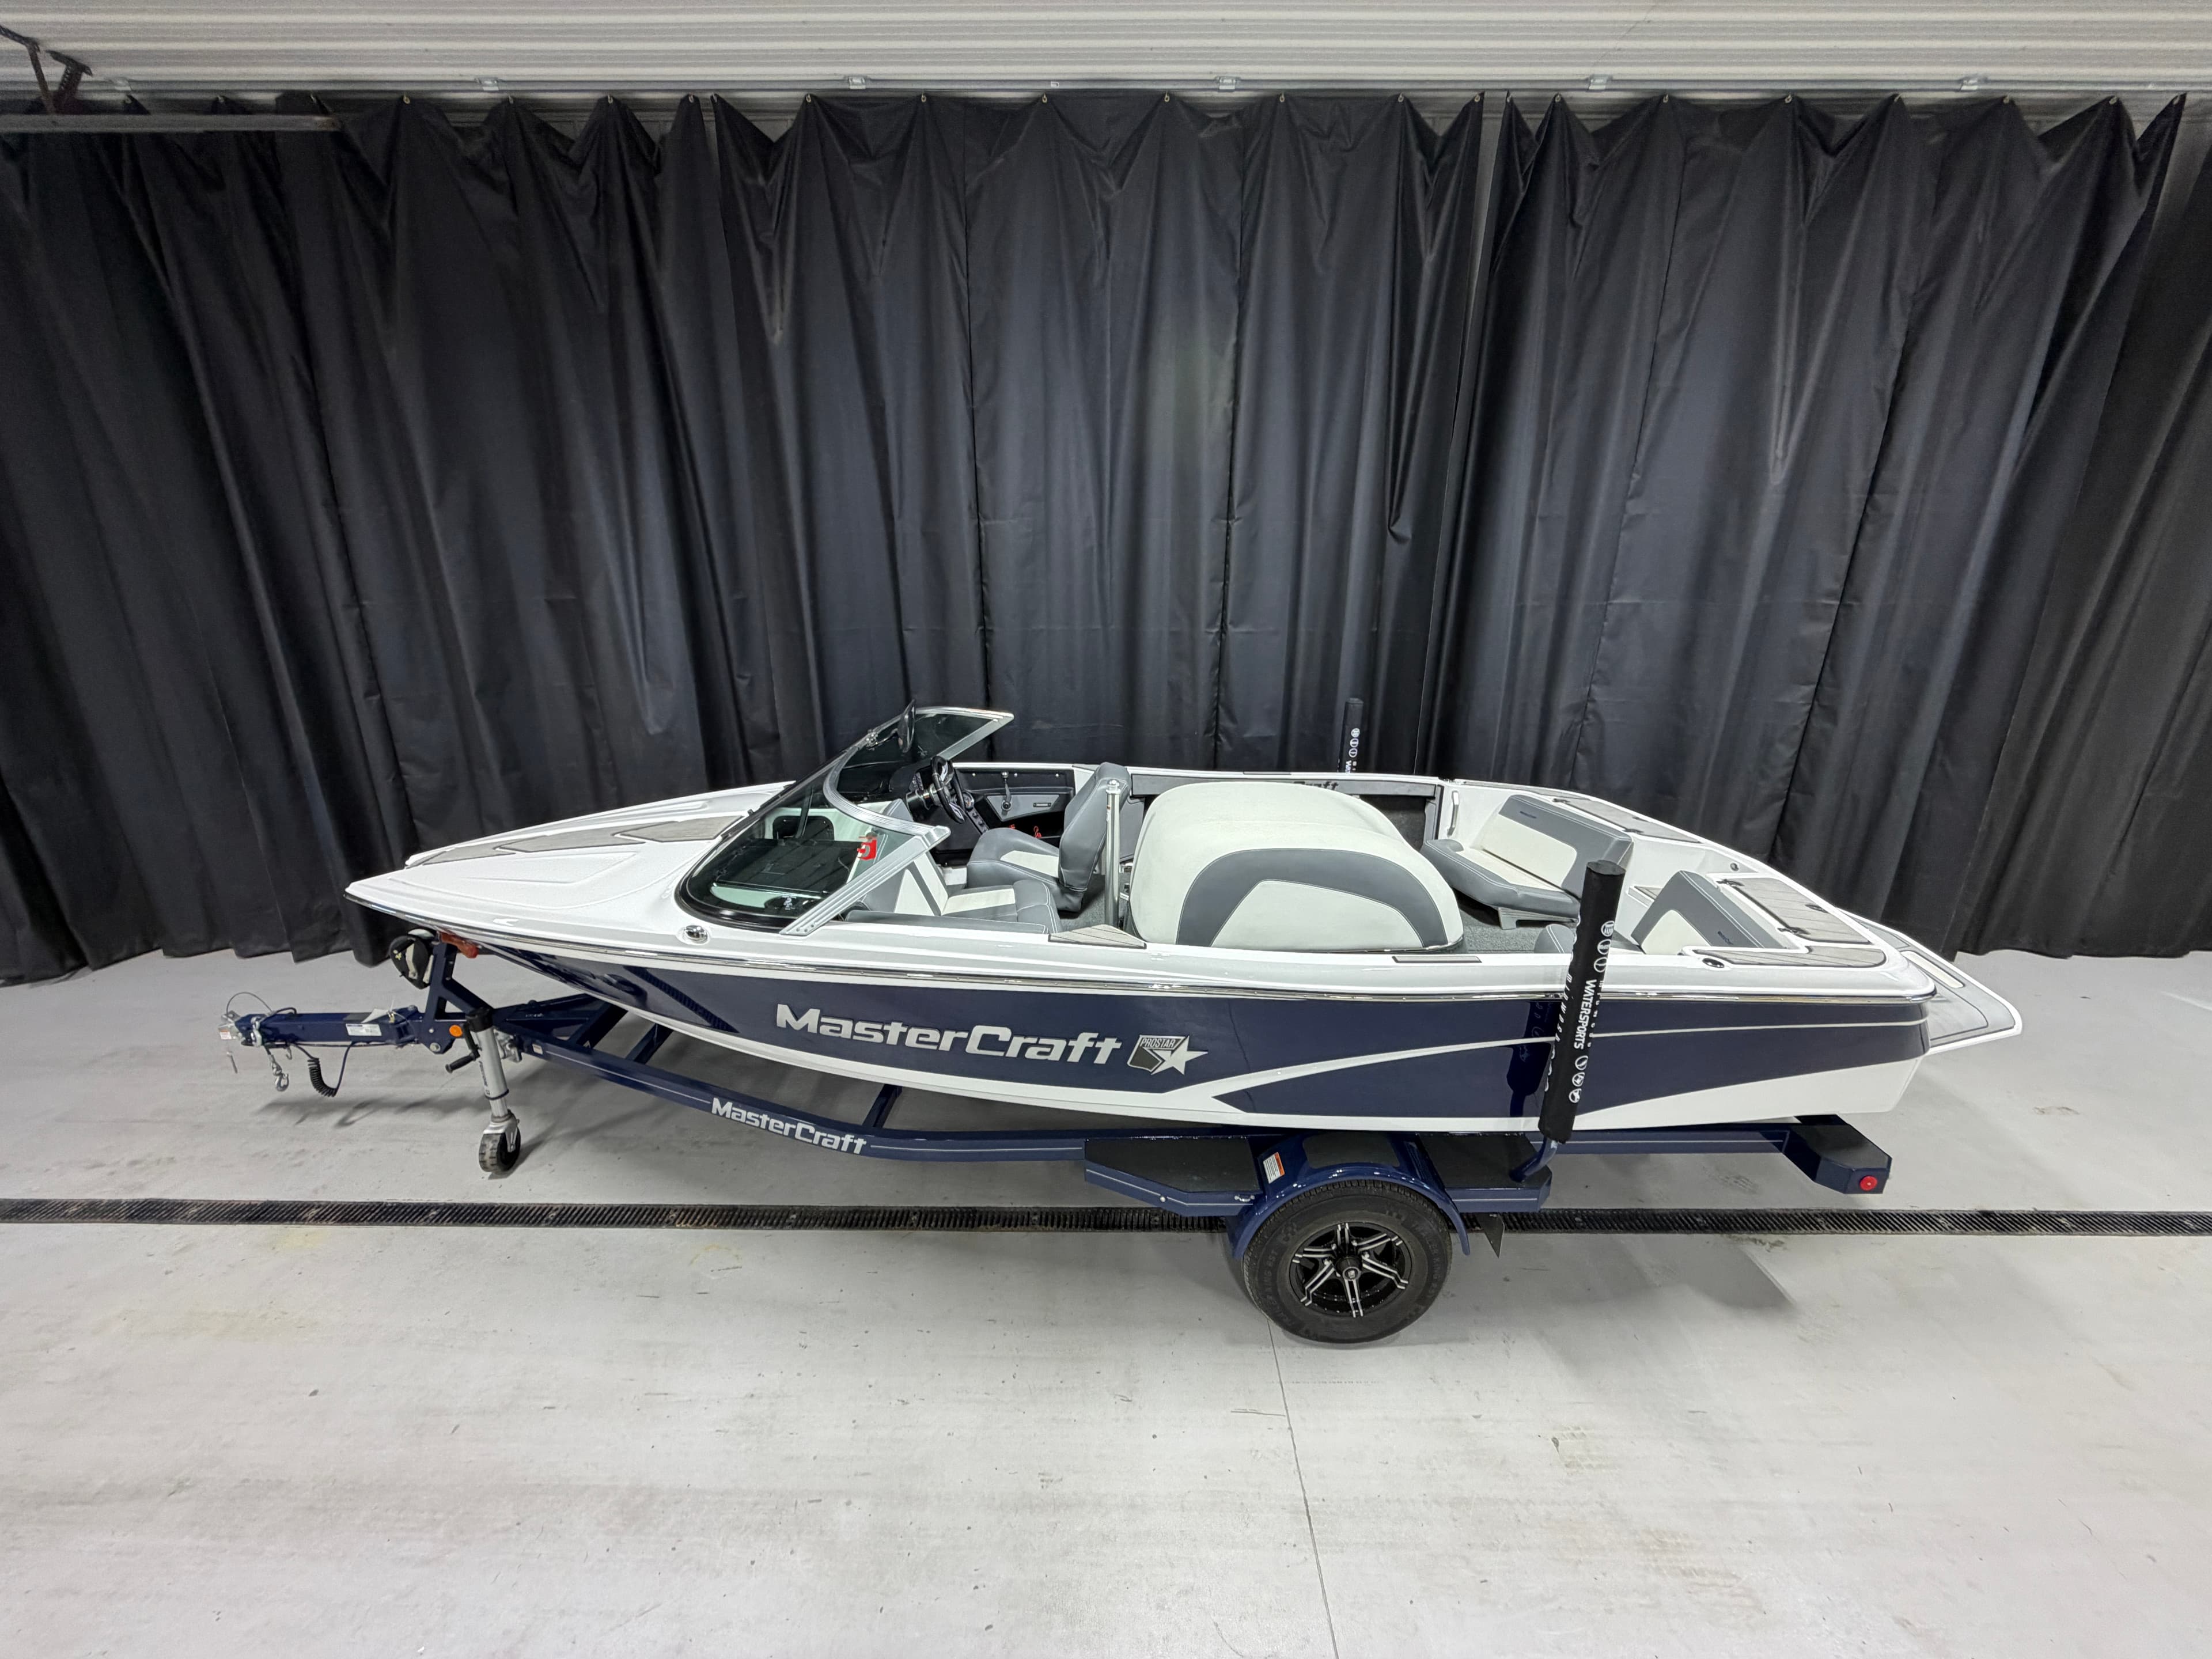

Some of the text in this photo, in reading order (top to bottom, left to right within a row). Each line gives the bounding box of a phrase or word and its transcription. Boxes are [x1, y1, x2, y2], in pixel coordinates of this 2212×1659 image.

[777, 1004, 1122, 1064] MasterCraft
[1140, 1037, 1176, 1048] PROSTAR
[1574, 979, 1597, 1050] WATERSPORTS
[711, 1097, 866, 1154] MasterCraft
